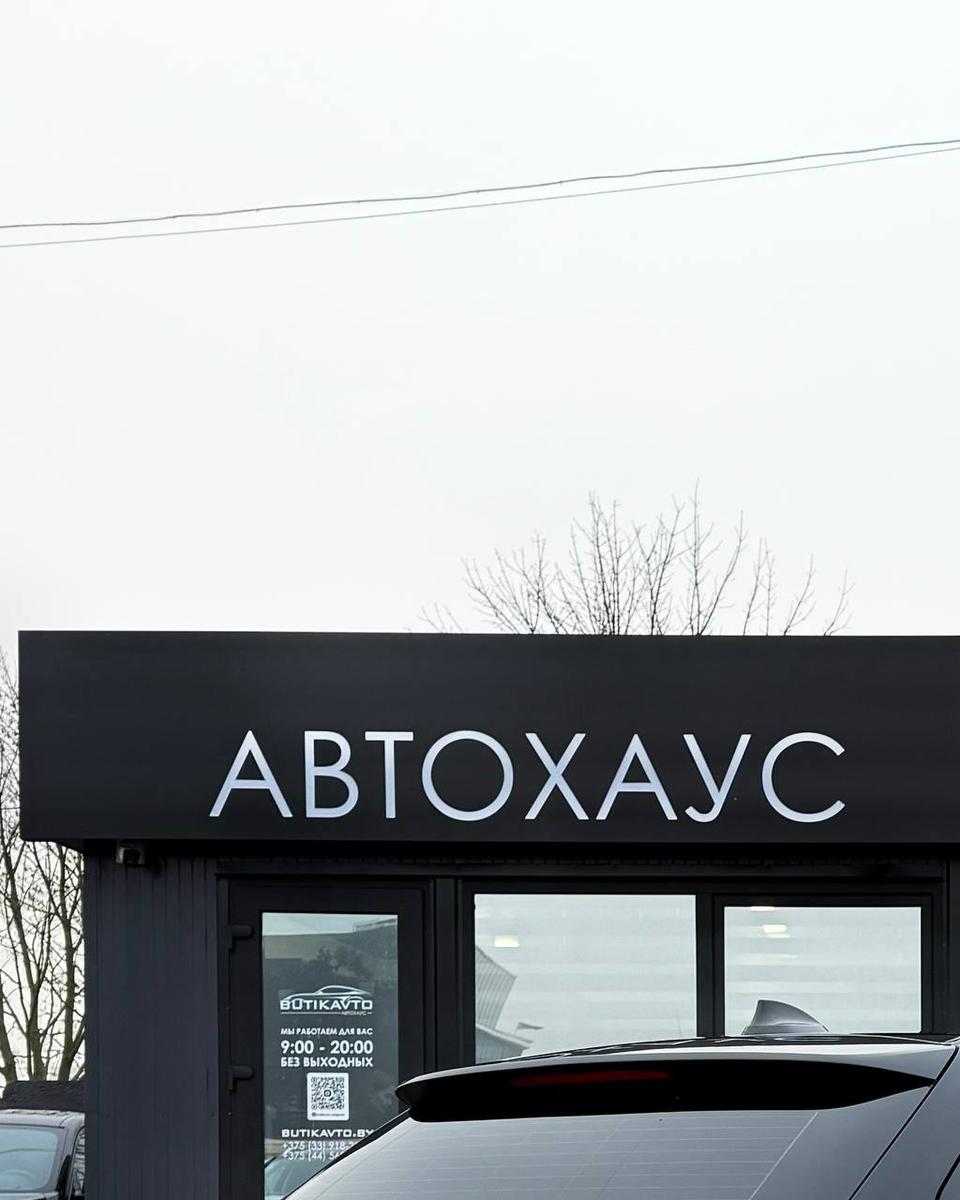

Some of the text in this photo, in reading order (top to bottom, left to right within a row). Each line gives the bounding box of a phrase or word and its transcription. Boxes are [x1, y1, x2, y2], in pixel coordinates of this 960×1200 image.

[209, 729, 846, 823] АВТОХАУС
[280, 999, 373, 1011] BUTIKAVTO
[281, 1028, 373, 1036] МЫ РАБОТАЕМ ДЛЯ ВАС
[280, 1040, 314, 1054] 9:00
[330, 1040, 373, 1054] 20:00
[280, 1057, 373, 1068] БЕЗ ВЫХОДНЫХ
[282, 1141, 305, 1150] +375
[308, 1141, 326, 1151] (33)
[308, 1151, 326, 1162] (44)
